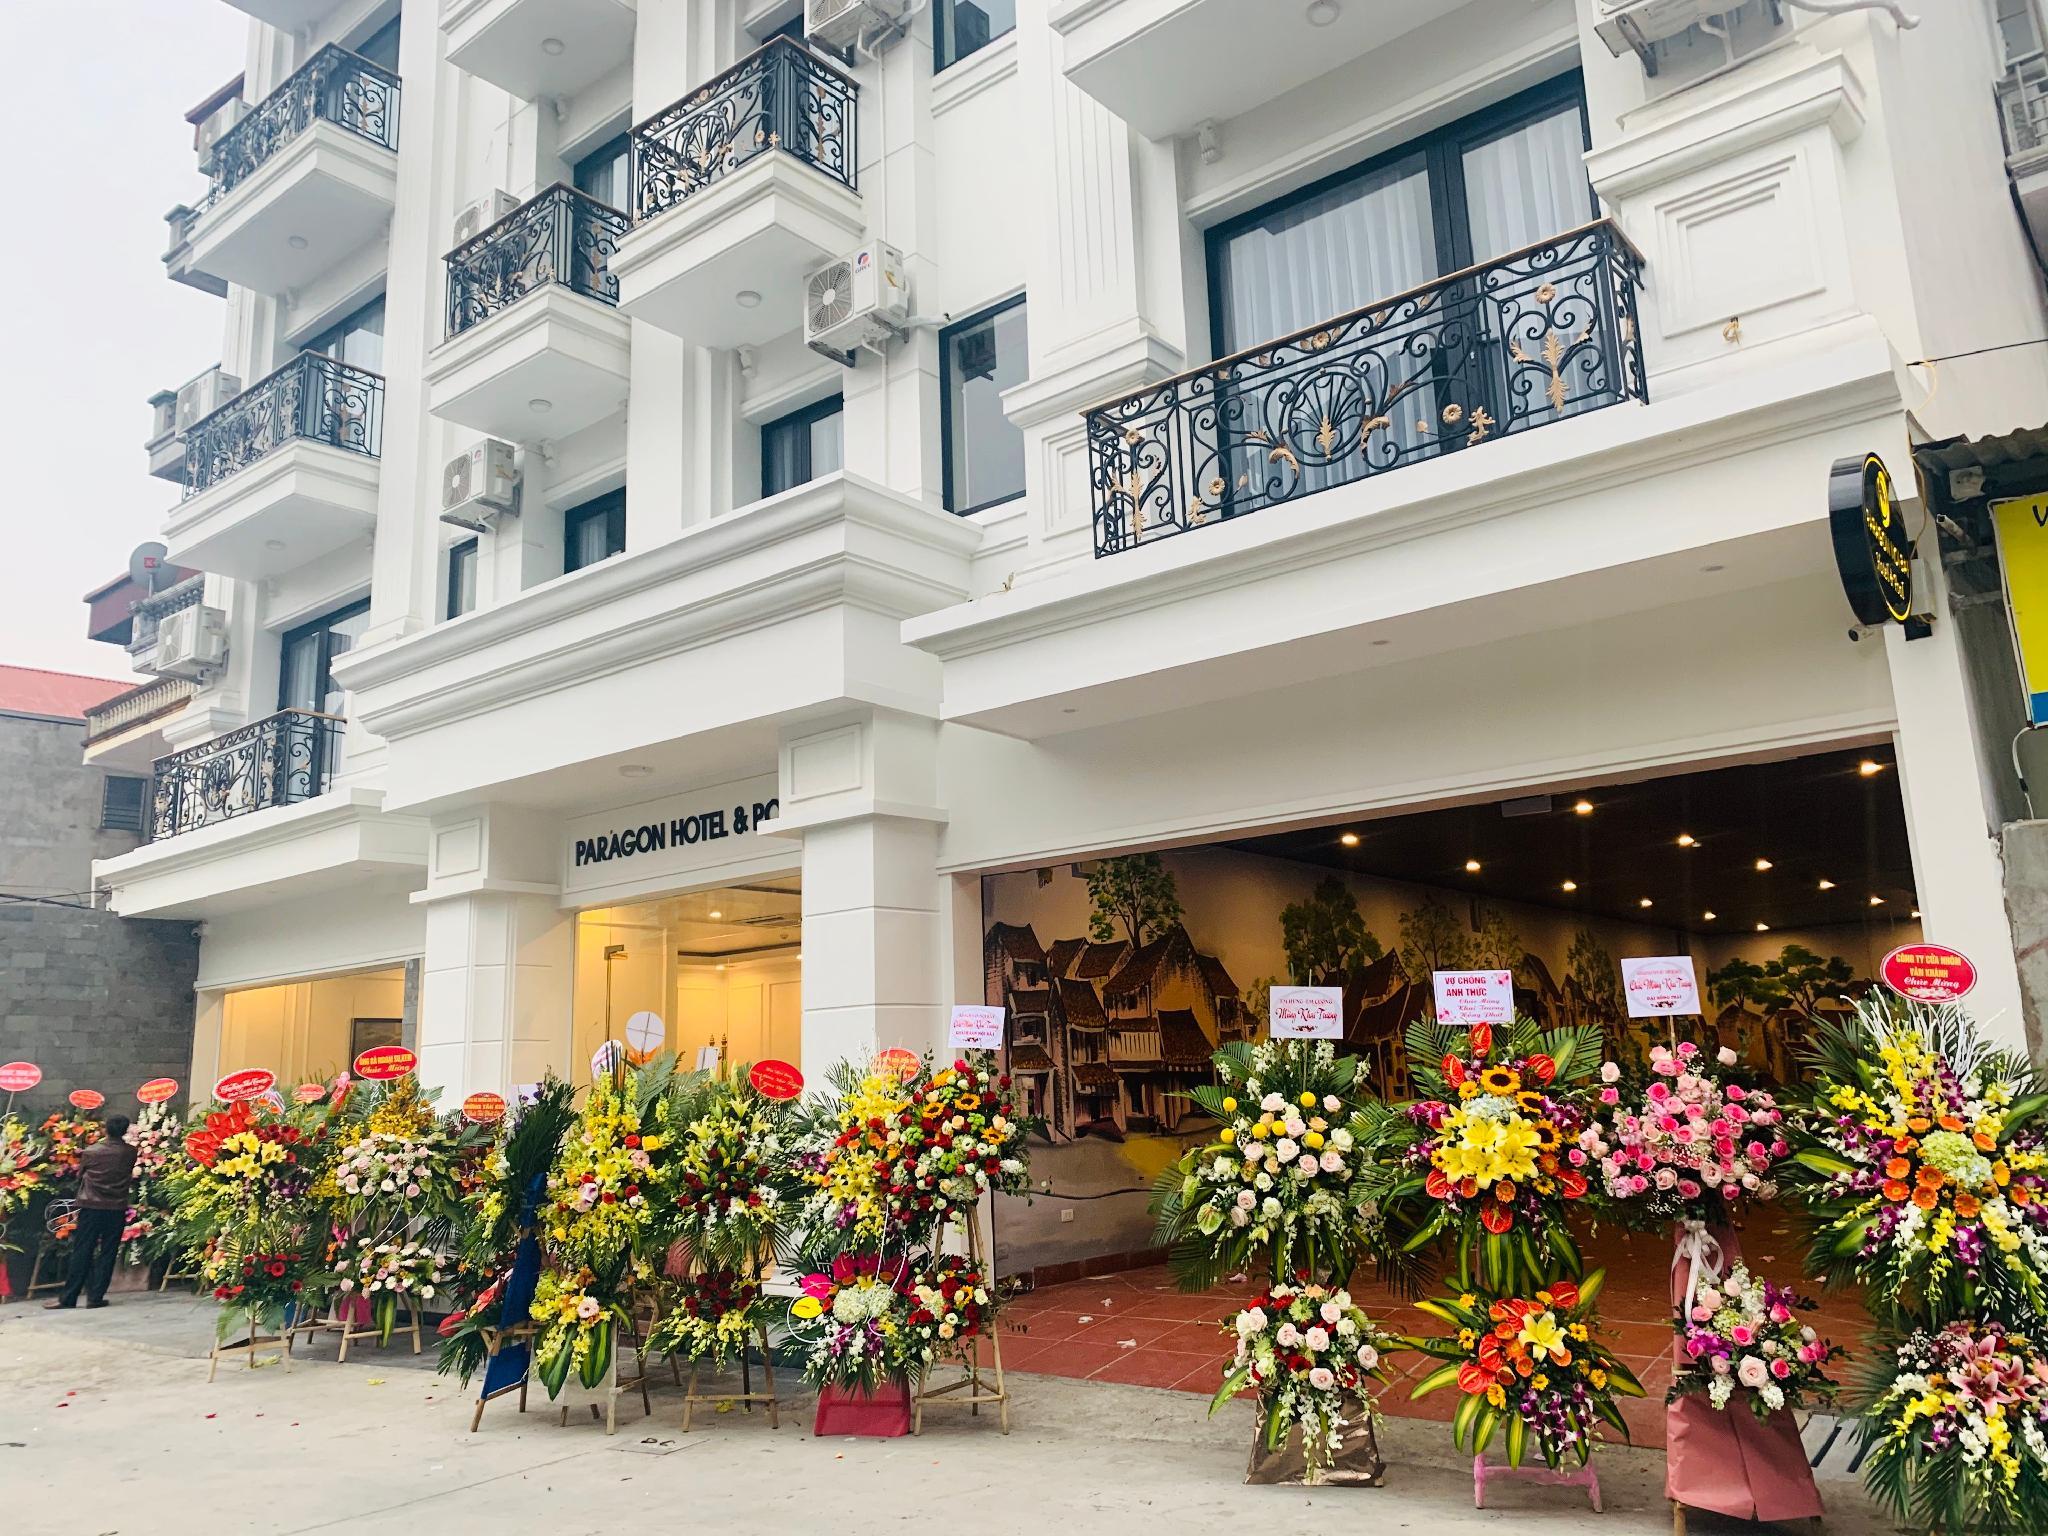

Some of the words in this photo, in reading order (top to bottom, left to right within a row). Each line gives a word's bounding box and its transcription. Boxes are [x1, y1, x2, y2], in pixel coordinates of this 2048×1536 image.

[576, 823, 665, 866] PARAGON
[671, 810, 728, 847] HOTEL
[733, 806, 748, 834] &
[1446, 989, 1463, 997] ANH
